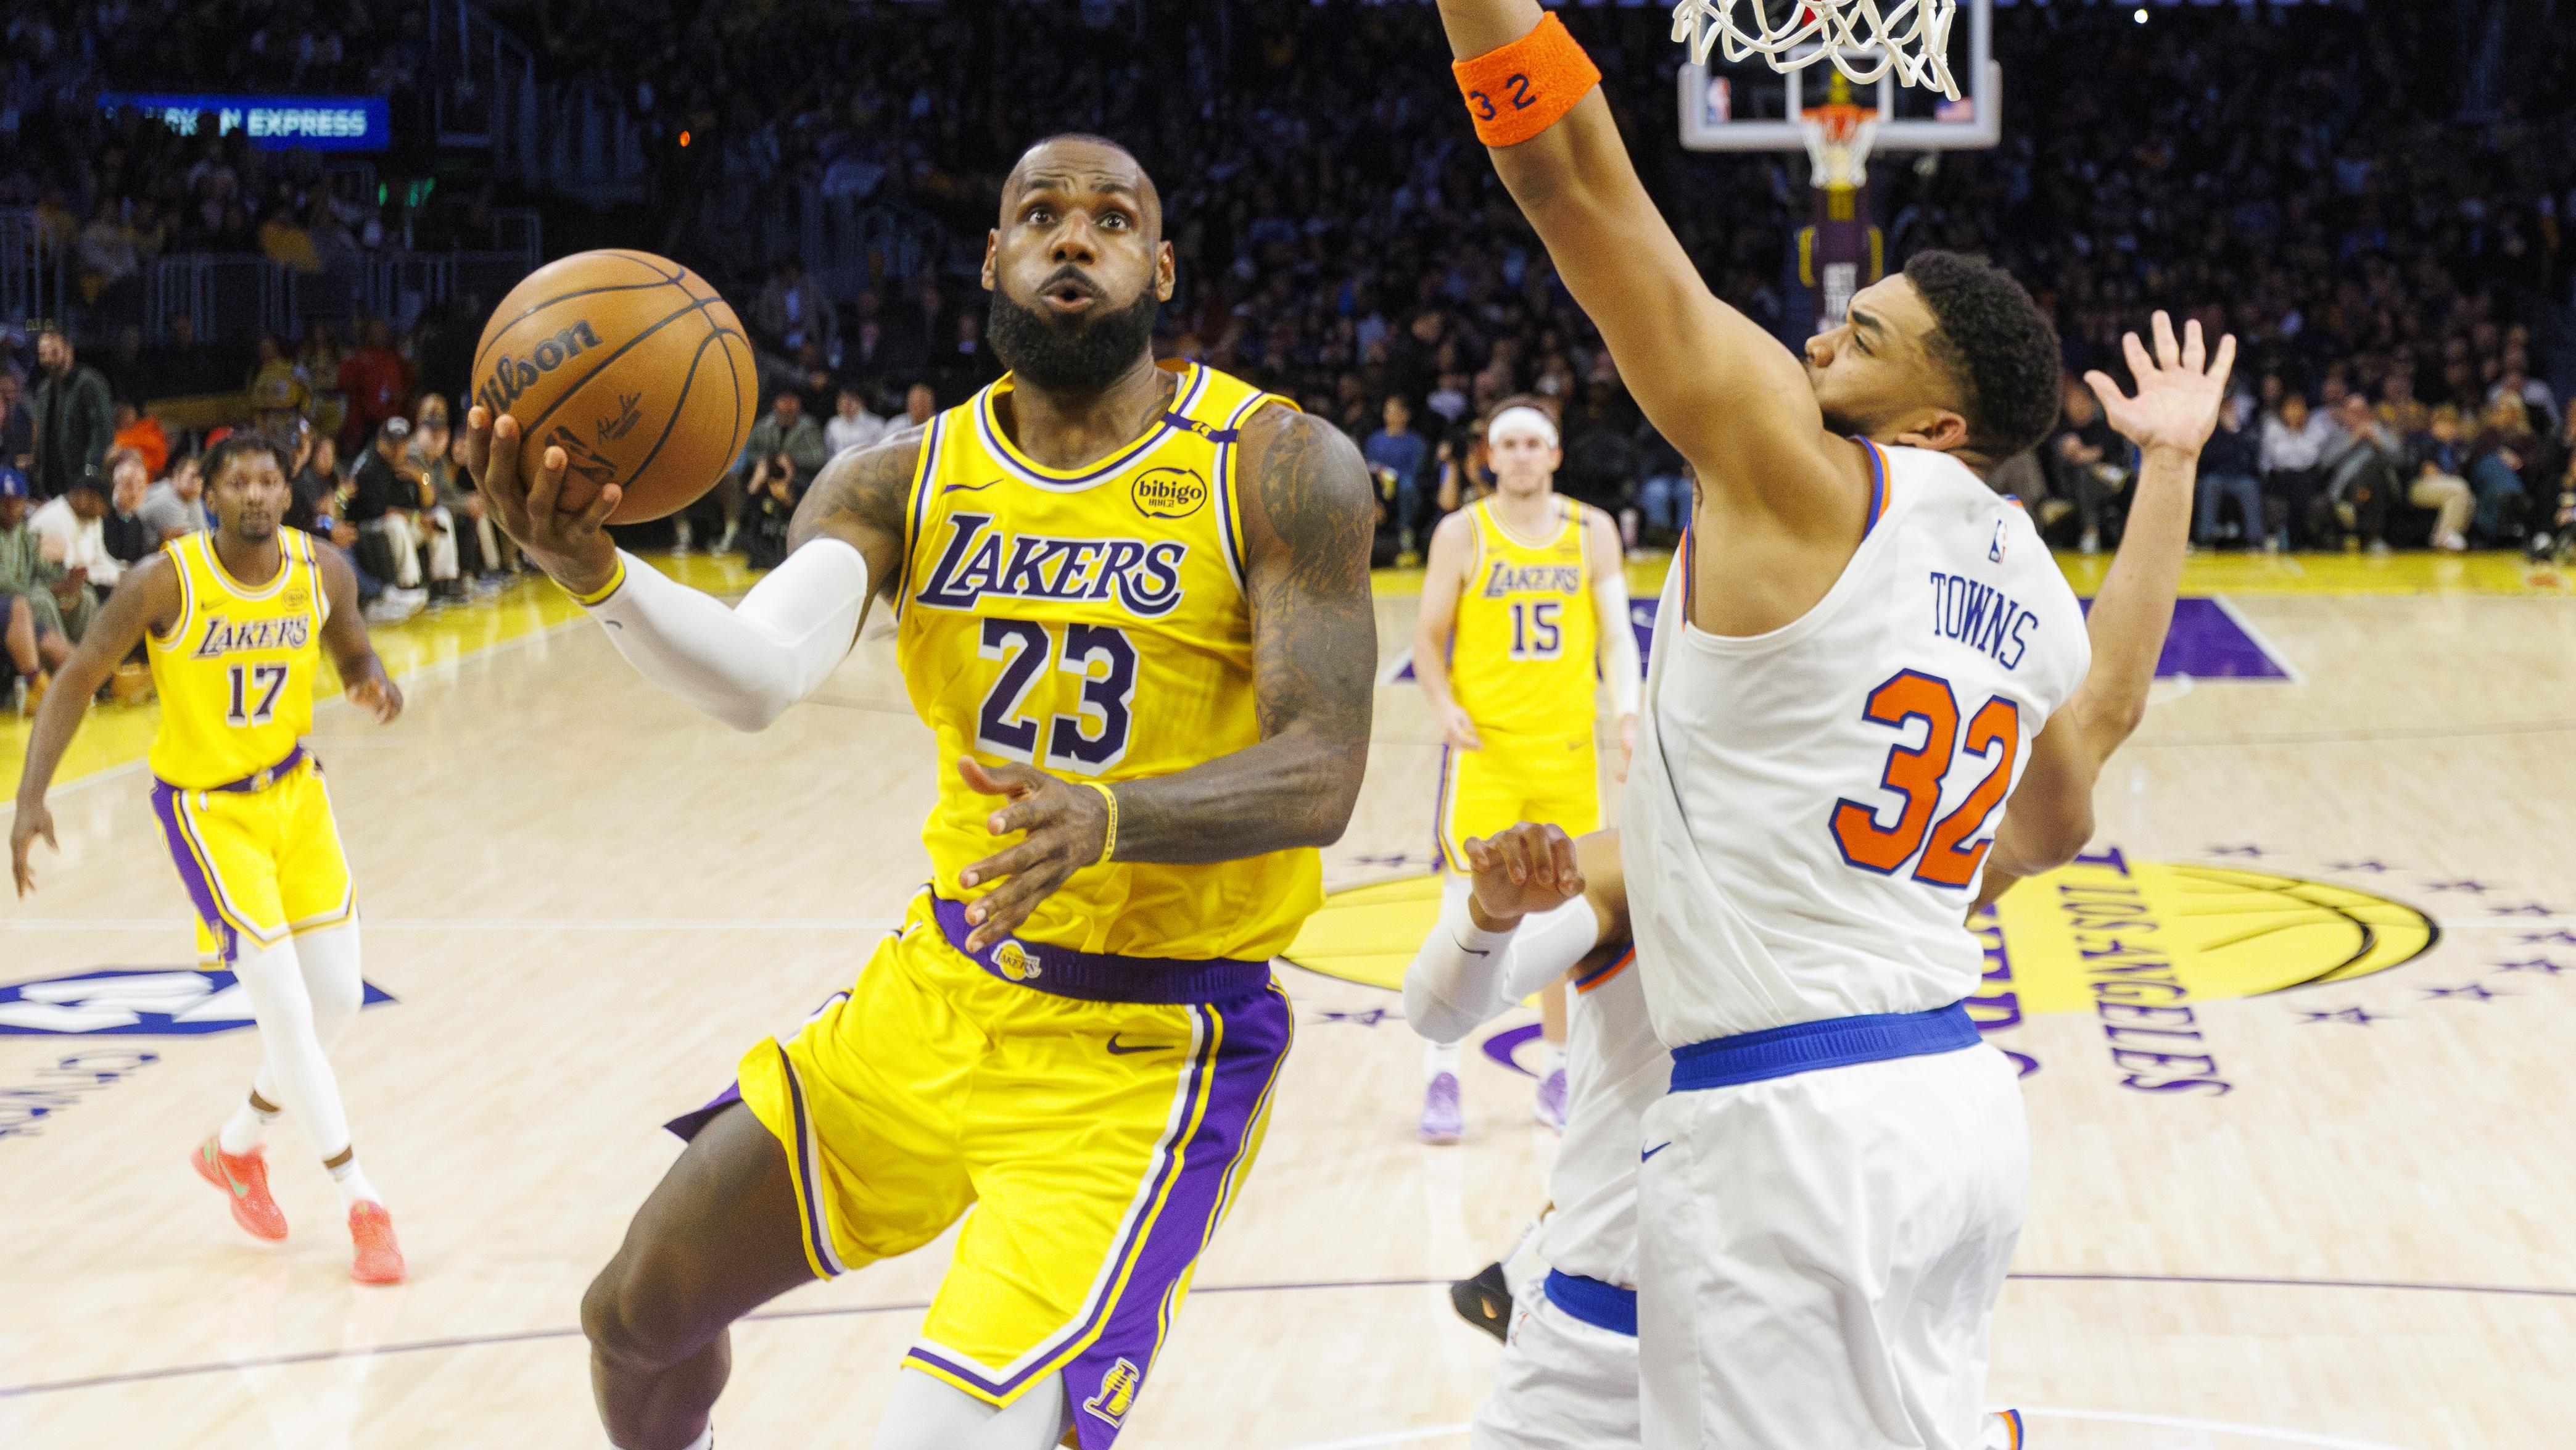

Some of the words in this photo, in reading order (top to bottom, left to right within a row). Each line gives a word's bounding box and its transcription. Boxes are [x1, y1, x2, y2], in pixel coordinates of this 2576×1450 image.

[248, 107, 366, 137] EXPRESS
[1139, 480, 1202, 504] bibigo
[1149, 498, 1174, 508] 비비고
[915, 512, 1188, 618] LAKERS
[1483, 561, 1580, 597] LAKERS
[190, 615, 310, 660] LAKERS
[1509, 600, 1563, 660] 15
[1930, 571, 2038, 671] TOWNS
[226, 662, 288, 727] 17
[975, 617, 1139, 777] 23
[1828, 668, 2020, 890] 32
[2074, 932, 2233, 1096] ANGELES
